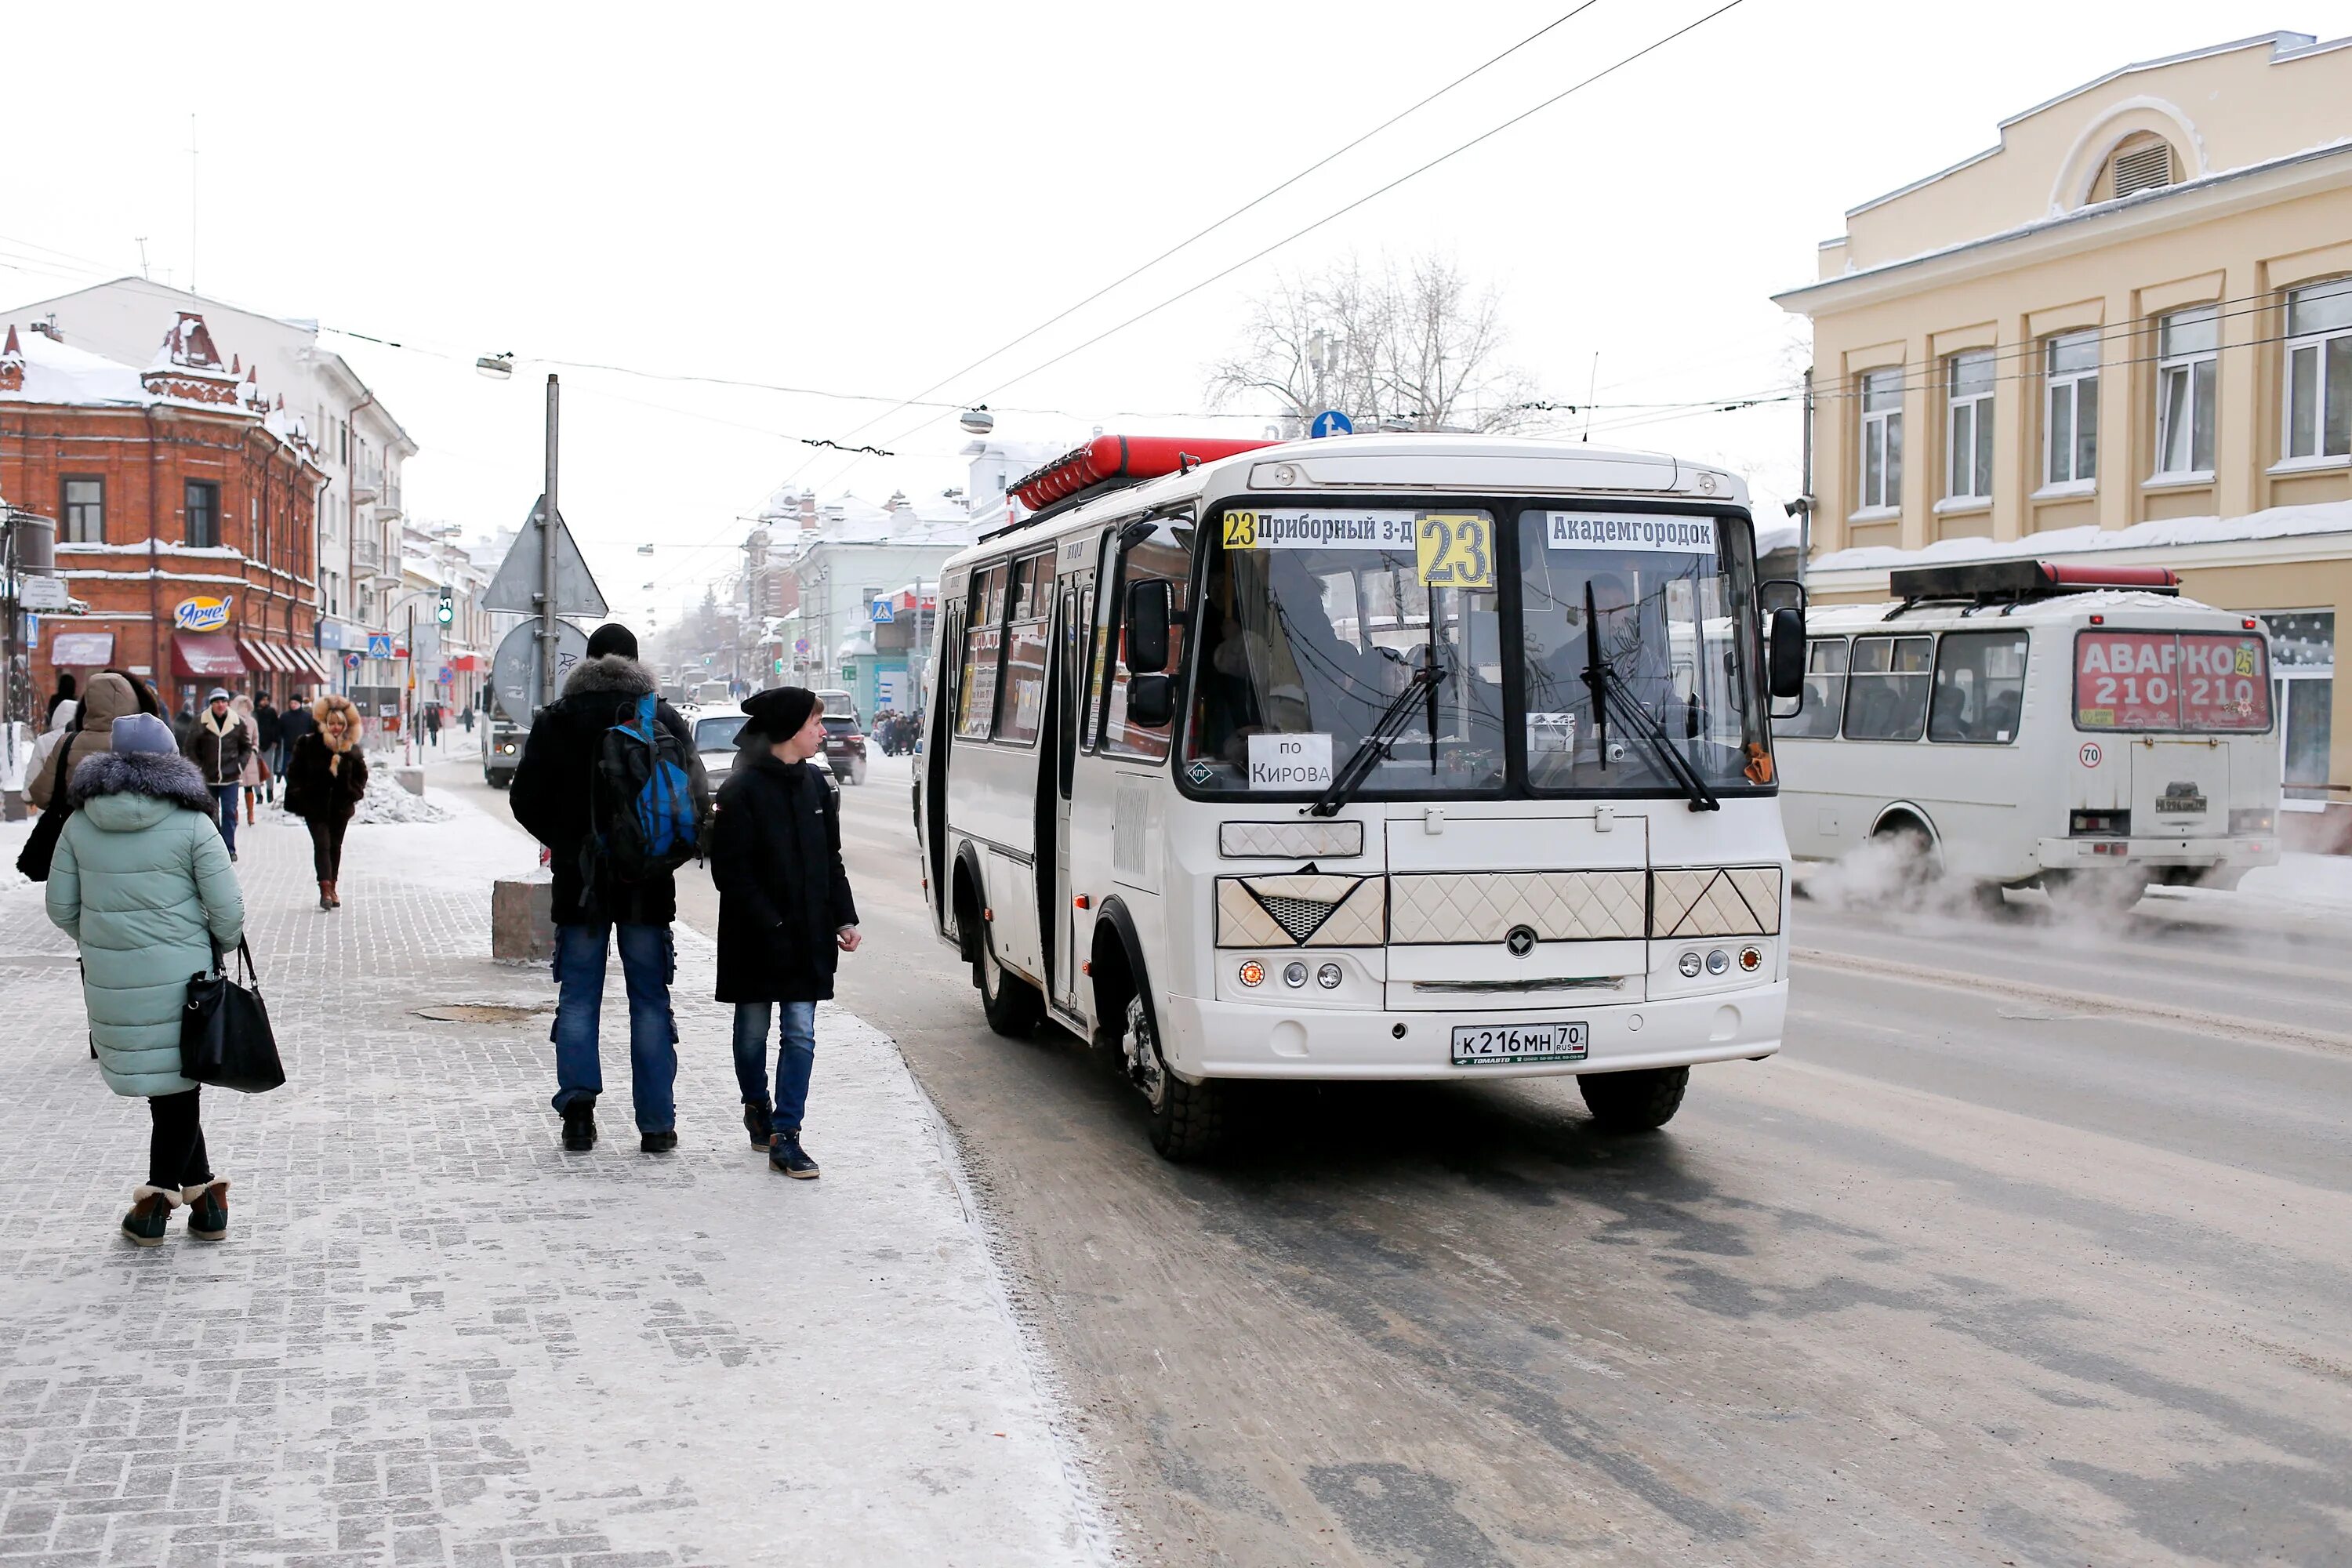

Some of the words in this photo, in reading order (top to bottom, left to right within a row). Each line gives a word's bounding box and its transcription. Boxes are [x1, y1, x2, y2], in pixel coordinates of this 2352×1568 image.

[1225, 513, 1254, 545] 23
[1258, 514, 1376, 544] Приборный
[1383, 521, 1413, 543] з-д
[1553, 516, 1711, 547] Академгородок
[1421, 519, 1487, 583] 23
[176, 597, 231, 627] Ярче!
[2082, 643, 2262, 677] АВАРКО
[2236, 652, 2252, 673] 25
[2095, 677, 2253, 705] 210-210
[2083, 750, 2098, 761] 70
[1558, 1027, 1579, 1044] 70
